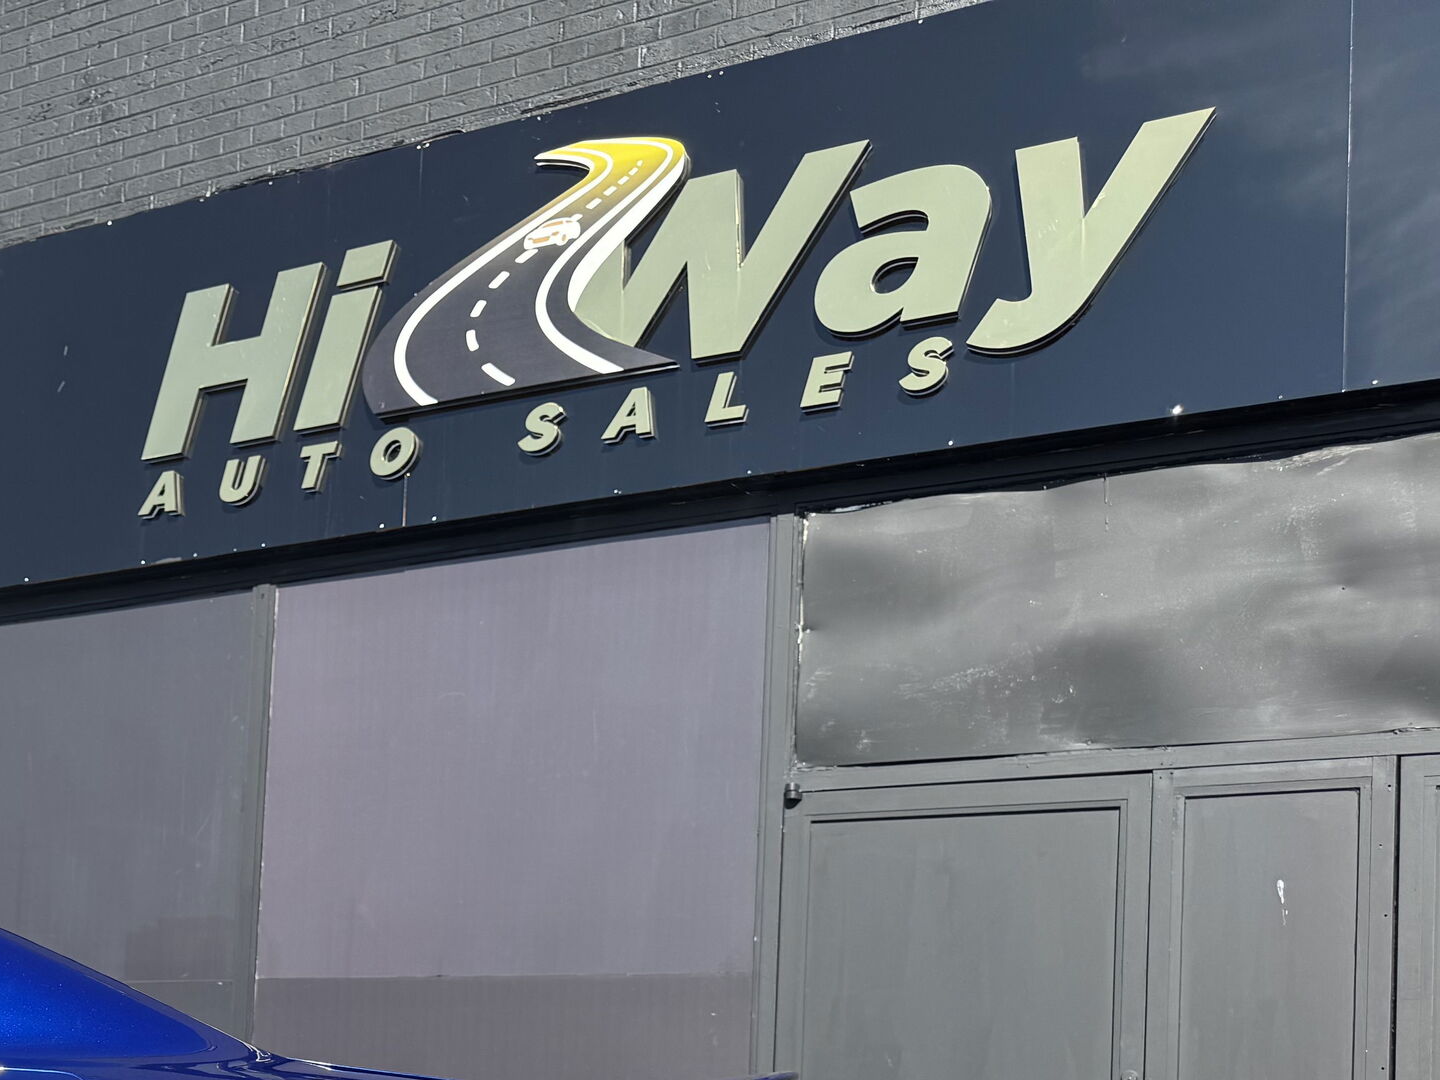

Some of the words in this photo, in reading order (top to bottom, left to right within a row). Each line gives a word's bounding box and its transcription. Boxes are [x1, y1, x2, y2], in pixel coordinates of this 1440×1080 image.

[140, 239, 400, 463] Hi
[572, 106, 1217, 362] Way
[137, 426, 422, 519] AUTO
[516, 335, 955, 457] SALES
